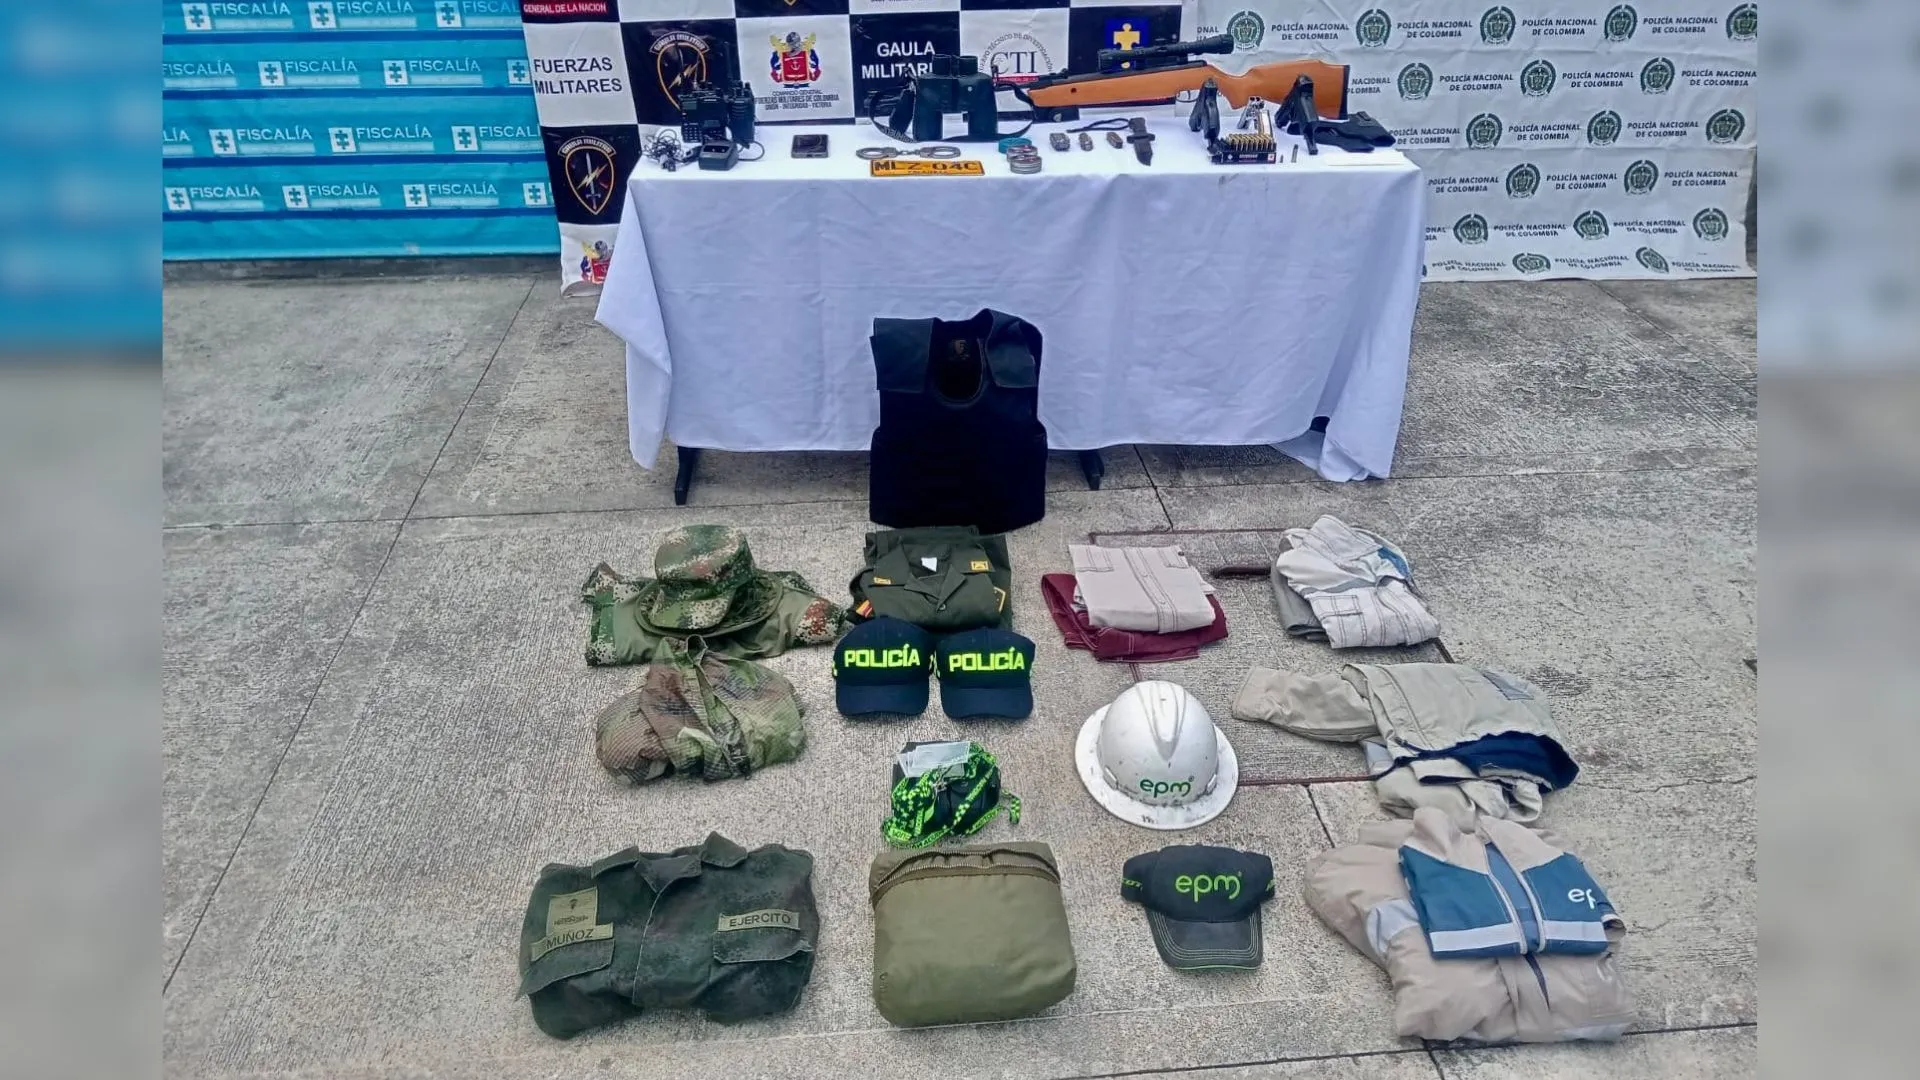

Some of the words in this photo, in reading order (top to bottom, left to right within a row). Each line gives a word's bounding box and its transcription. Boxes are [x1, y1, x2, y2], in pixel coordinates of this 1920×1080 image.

[210, 1, 291, 16] FISCALÍA
[336, 0, 414, 14] FISCALÍA
[463, 1, 520, 13] FISCAL
[523, 3, 554, 14] GENERAL
[555, 4, 566, 13] DE
[567, 3, 578, 13] LA
[1271, 22, 1305, 32] POLICÍA
[1306, 23, 1349, 31] NACIONAL
[1522, 18, 1554, 27] POLICÍA
[1555, 18, 1597, 26] NACIONAL
[1643, 16, 1674, 25] POLICÍA
[1675, 17, 1718, 25] NACIONAL
[1294, 32, 1339, 40] COLOMBIA
[877, 41, 935, 57] GAULA
[284, 57, 357, 73] FISCALÍA
[409, 57, 481, 72] FISCALÍA
[534, 57, 613, 74] FUERZAS
[990, 51, 1038, 75] CTI
[862, 62, 933, 79] MILITAR
[1562, 71, 1590, 80] POLICÍA
[1681, 69, 1714, 78] POLICÍA
[1715, 70, 1757, 78] NACIONA
[1439, 74, 1471, 82] POLICÍA
[1583, 80, 1624, 88] COLOMBIA
[1689, 79, 1700, 87] DE
[1702, 79, 1749, 87] COLOMBIA
[534, 78, 623, 95] MILITARES
[1462, 83, 1502, 91] COLOMBIA
[356, 124, 432, 139] FISCALÍA
[1508, 123, 1539, 133] POLICÍA
[1627, 120, 1657, 129] POLICÍA
[236, 125, 313, 141] FISCALÍA
[1428, 177, 1457, 186] POLICÍA
[1458, 176, 1499, 184] NACIONAL
[1546, 173, 1577, 181] POLICÍA
[1664, 170, 1693, 178] POLICÍA
[189, 184, 262, 199] FISCALÍA
[308, 182, 379, 197] FISCALÍA
[428, 181, 497, 195] FISCALÍA
[1447, 185, 1488, 193] COLOMBIA
[844, 643, 921, 668] POLICÍA
[948, 647, 1025, 672] POLICÍA
[1139, 778, 1193, 798] epm
[1175, 873, 1242, 902] epm
[729, 912, 792, 928] EJERCITO
[546, 928, 594, 950] MUÑOZ
